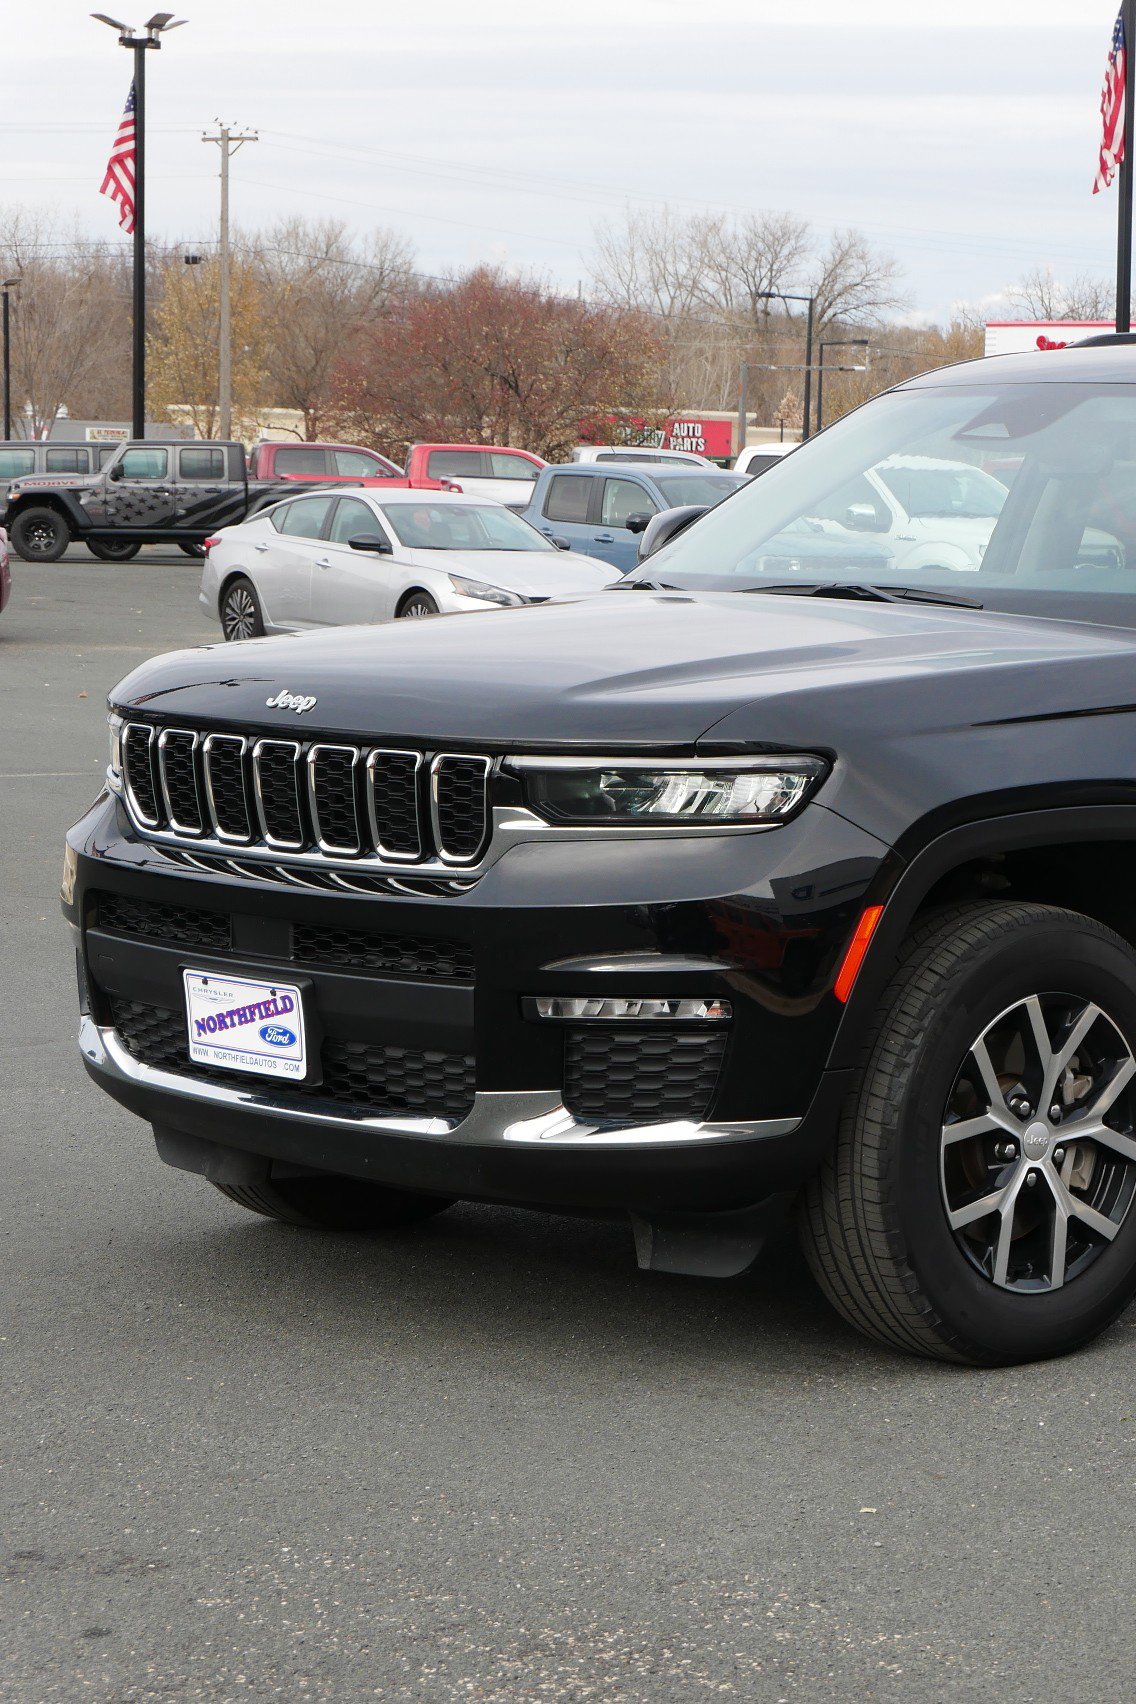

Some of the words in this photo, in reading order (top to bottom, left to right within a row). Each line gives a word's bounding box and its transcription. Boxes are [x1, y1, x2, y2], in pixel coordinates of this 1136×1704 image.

[672, 422, 702, 437] AUTO
[669, 436, 705, 451] PARTS
[265, 689, 317, 715] Jeep
[192, 986, 234, 998] CHRYSLER
[194, 995, 294, 1037] NORTHFIELD
[265, 1026, 290, 1044] Ford
[1026, 1134, 1048, 1147] Jeep
